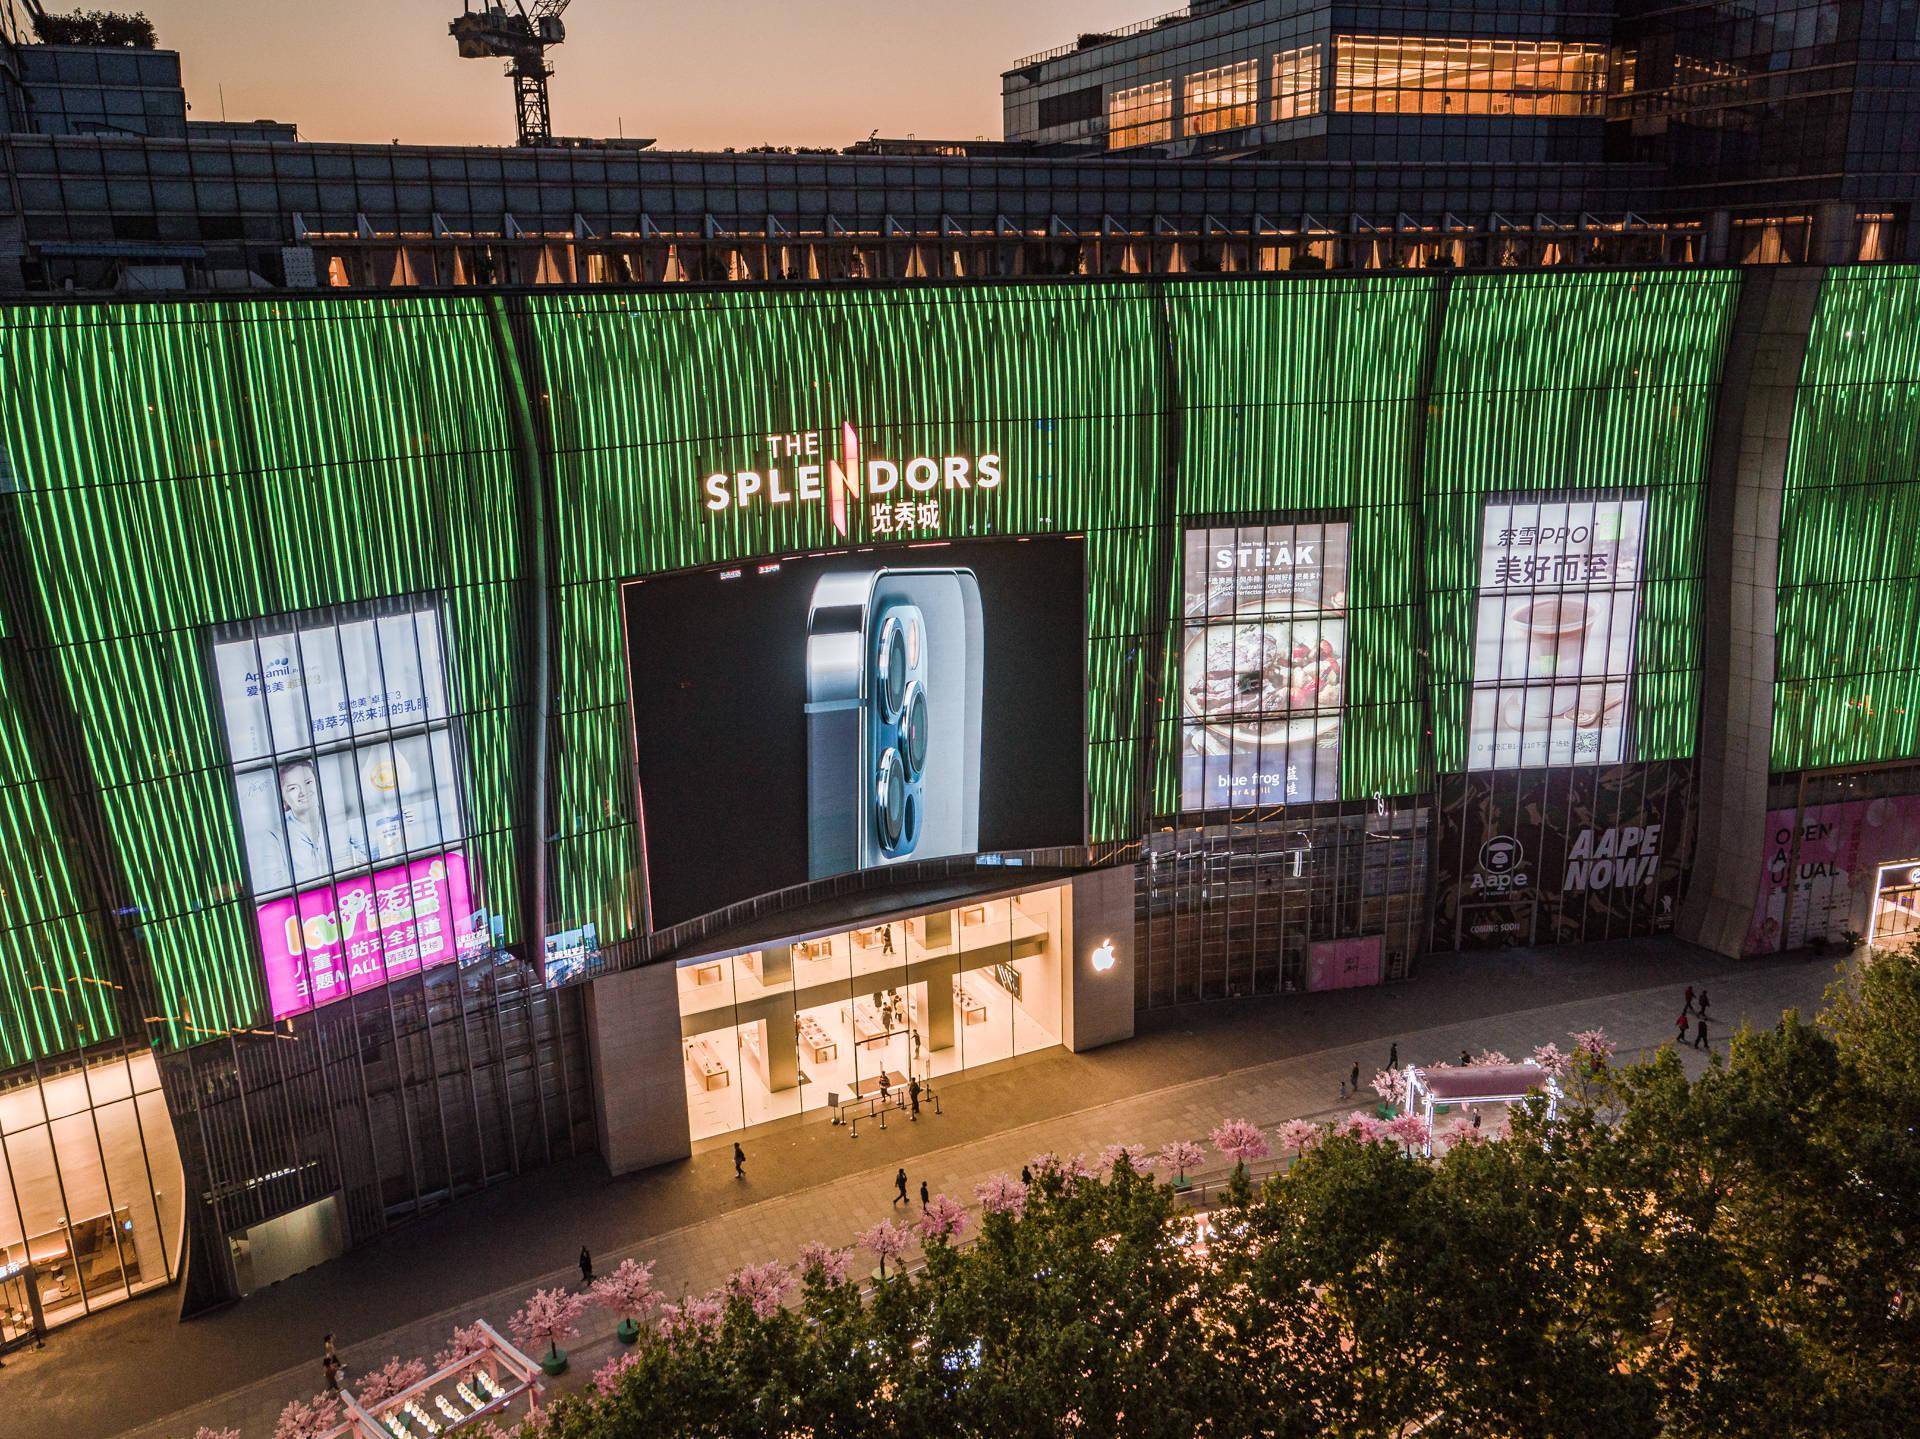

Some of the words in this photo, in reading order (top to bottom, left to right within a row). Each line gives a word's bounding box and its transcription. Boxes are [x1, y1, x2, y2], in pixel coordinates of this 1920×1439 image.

[766, 432, 819, 459] THE
[706, 421, 1001, 536] SPLENDORS
[871, 500, 940, 533] 览秀城
[1216, 546, 1314, 569] STEAK
[1495, 553, 1608, 584] 美好而至
[245, 665, 290, 682] Apamil
[1218, 774, 1248, 787] blue
[1252, 773, 1280, 787] frog
[1250, 786, 1271, 797] gill
[1568, 824, 1661, 860] AAPE
[1775, 823, 1833, 845] OEN
[1470, 873, 1528, 890] Aape
[1563, 856, 1659, 891] NOW!
[1771, 861, 1840, 884] UUAL
